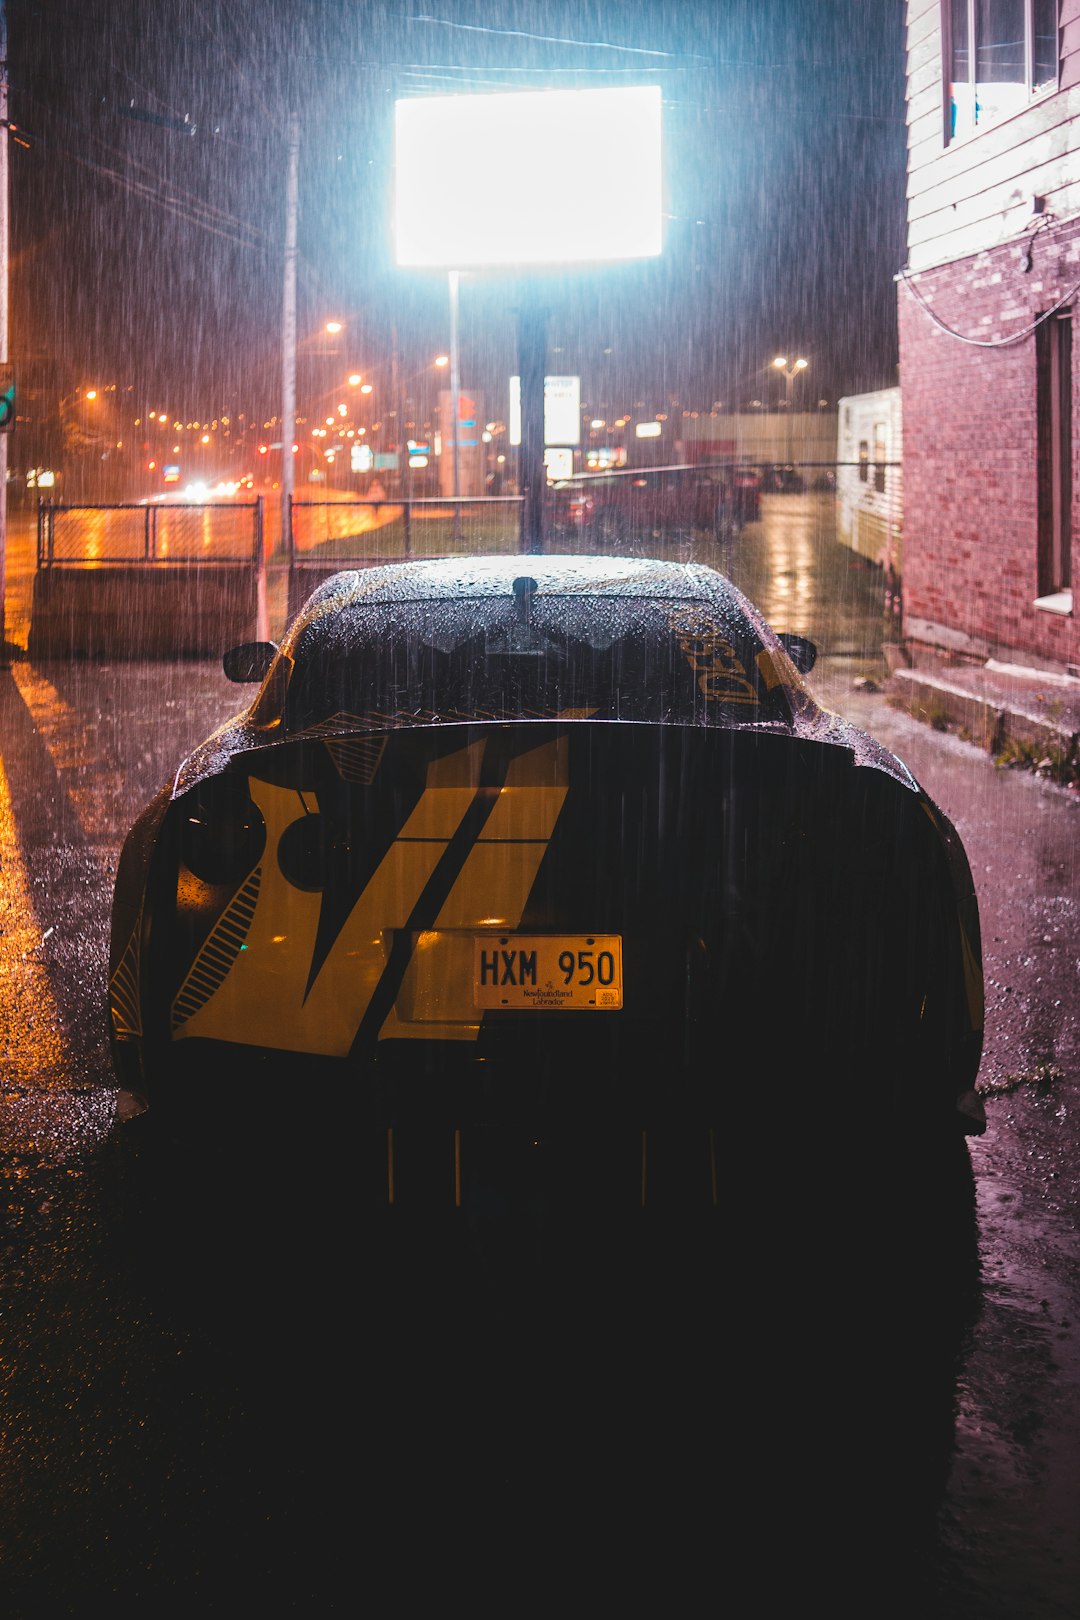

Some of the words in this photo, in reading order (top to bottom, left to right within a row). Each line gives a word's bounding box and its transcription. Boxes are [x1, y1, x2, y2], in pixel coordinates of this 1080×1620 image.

[480, 950, 537, 986] HXM
[558, 950, 615, 986] 950
[523, 989, 573, 999] Newfoundland
[532, 998, 565, 1006] Labrador
